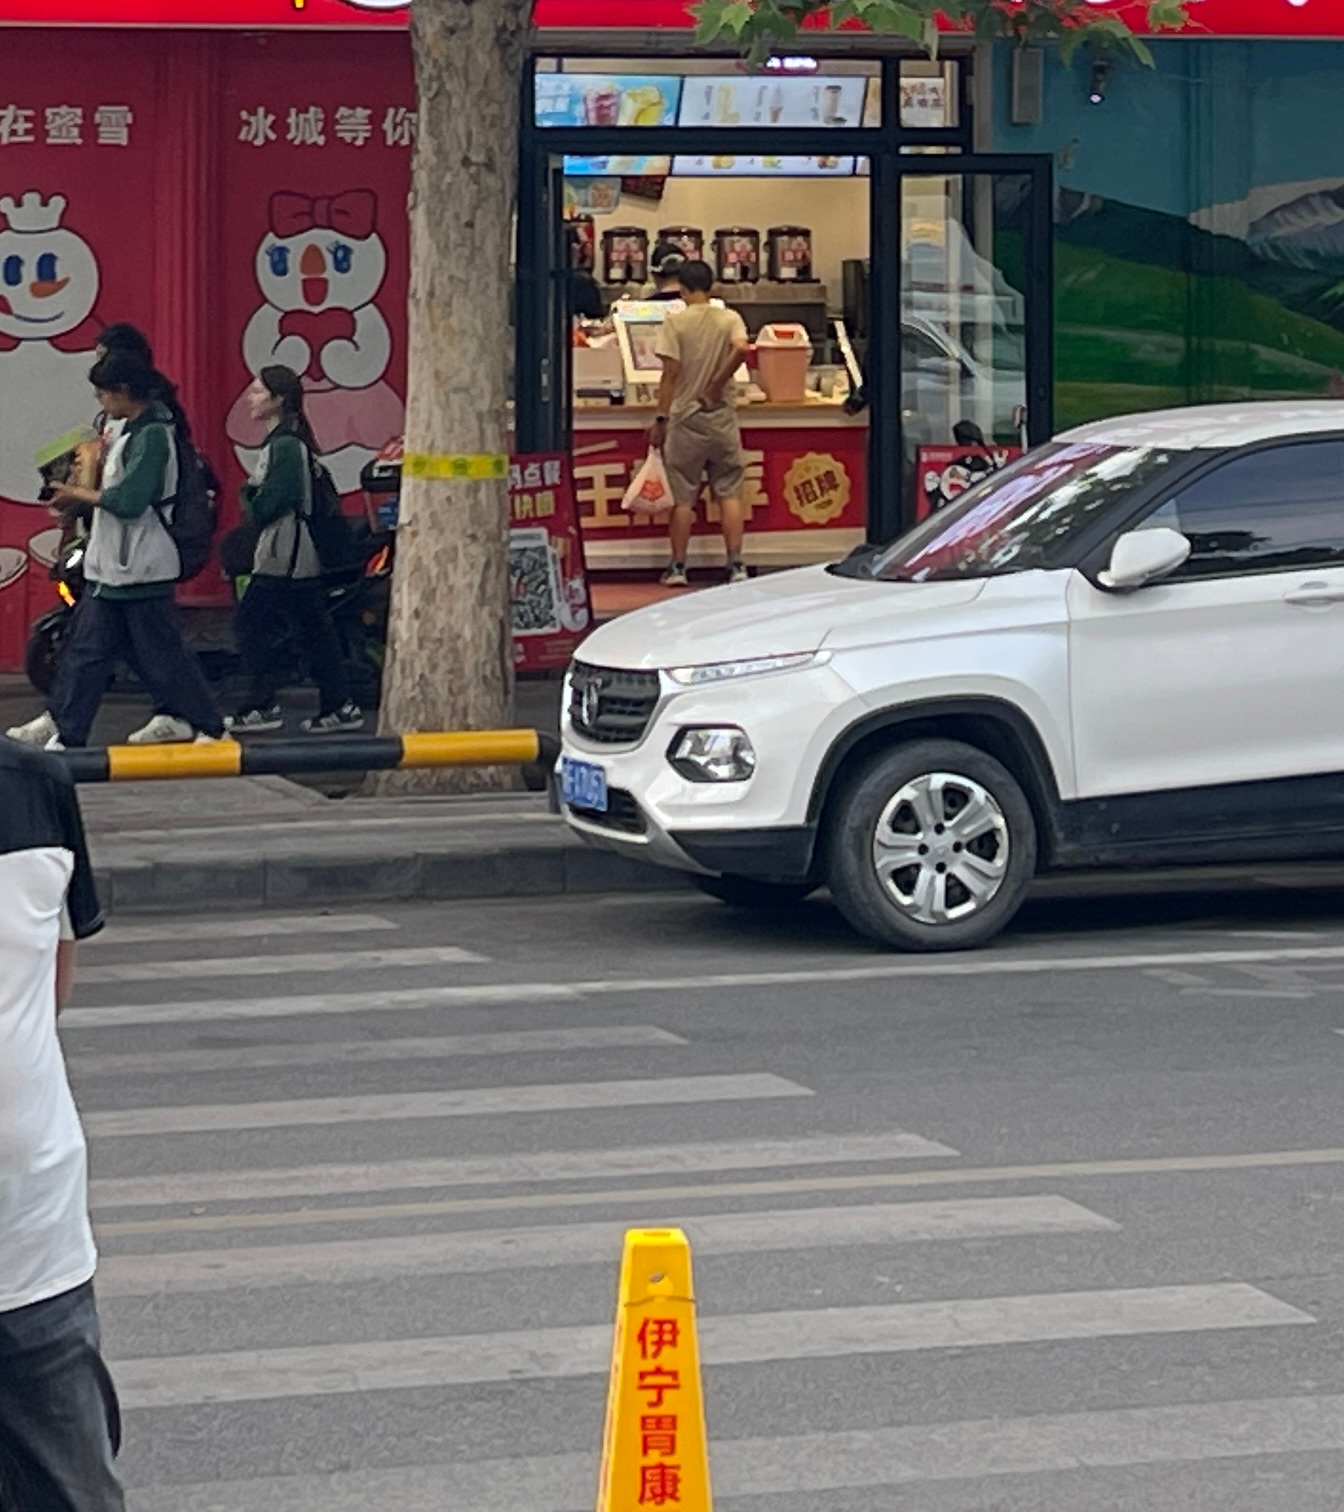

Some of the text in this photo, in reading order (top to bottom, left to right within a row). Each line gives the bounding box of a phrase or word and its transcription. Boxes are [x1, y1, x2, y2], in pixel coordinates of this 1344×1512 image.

[237, 106, 419, 146] 冰城等你
[637, 1317, 681, 1505] 伊宁胃康
